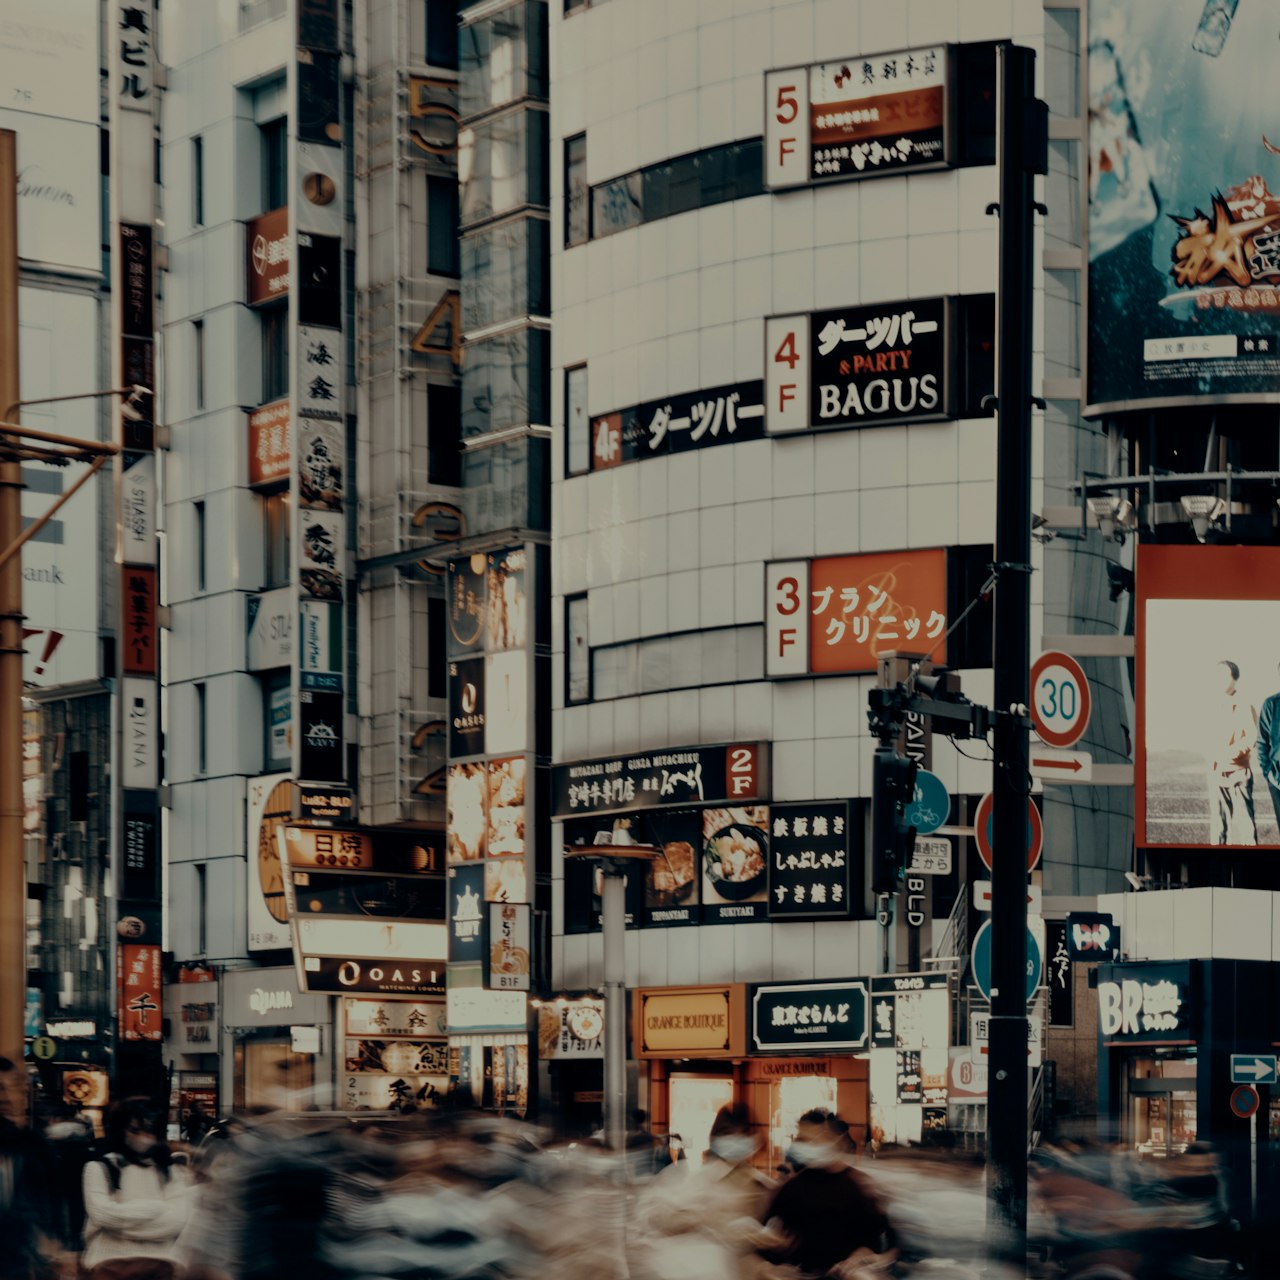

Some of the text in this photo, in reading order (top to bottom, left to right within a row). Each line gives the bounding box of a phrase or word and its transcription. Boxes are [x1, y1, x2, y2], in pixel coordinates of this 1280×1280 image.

[818, 311, 938, 356] ダーツバー
[853, 349, 913, 374] PARTY
[819, 374, 938, 418] BAGUS
[648, 391, 765, 450] ダーツバー
[24, 565, 65, 584] ank
[812, 584, 888, 615] ブラン
[825, 610, 946, 645] クリニック
[1040, 679, 1076, 720] 30
[775, 850, 845, 871] しゃぶしゃぶ
[647, 1014, 726, 1032] ORANGE BOUTIQUE
[1098, 978, 1142, 1036] BR
